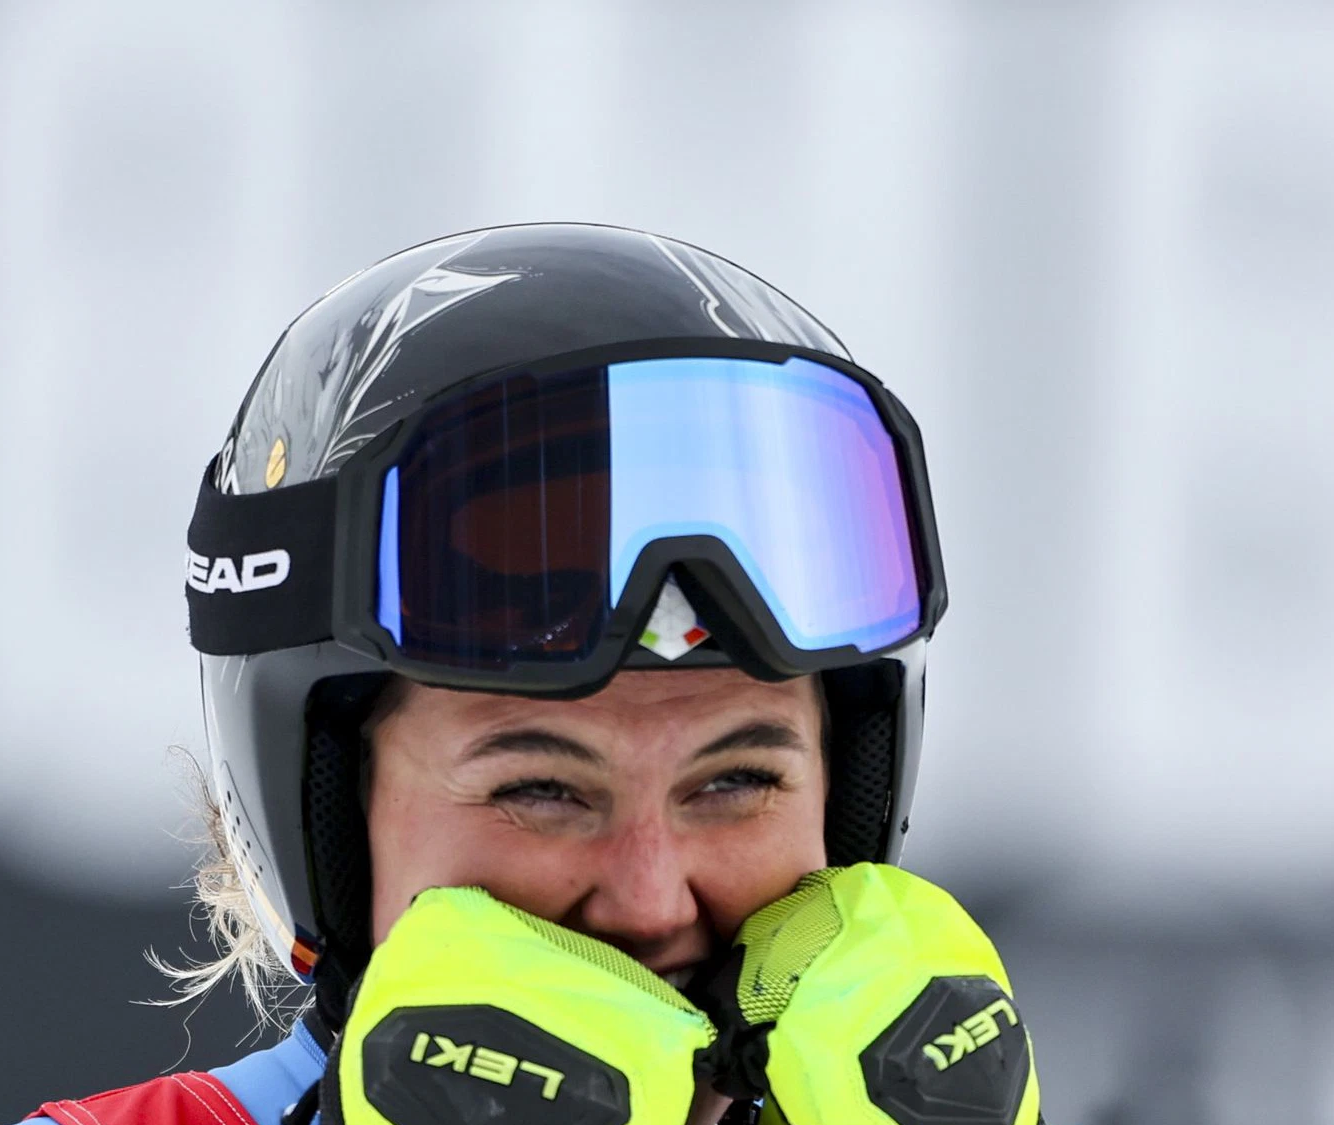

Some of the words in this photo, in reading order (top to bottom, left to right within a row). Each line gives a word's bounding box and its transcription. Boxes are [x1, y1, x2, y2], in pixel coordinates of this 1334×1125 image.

[185, 550, 291, 593] EAD
[410, 1032, 565, 1101] LEKI
[923, 998, 1018, 1071] LEKI
